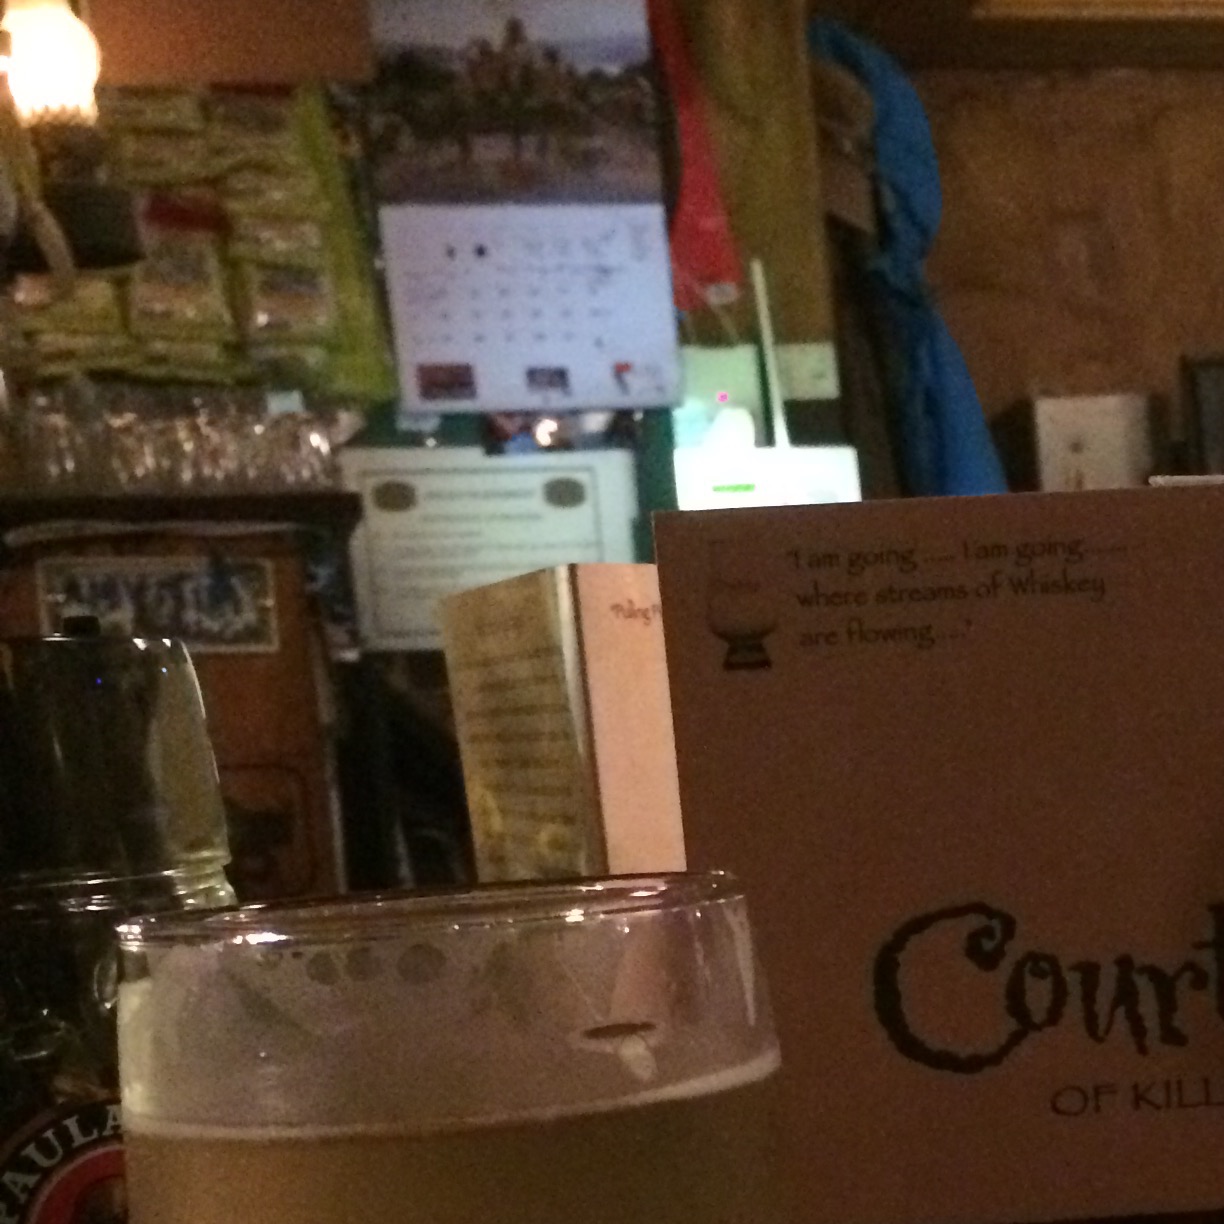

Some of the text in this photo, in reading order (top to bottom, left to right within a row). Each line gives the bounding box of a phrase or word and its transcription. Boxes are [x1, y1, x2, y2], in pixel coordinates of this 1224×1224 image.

[796, 567, 1106, 608] where streams of Whiskey
[799, 629, 838, 648] are
[1050, 1082, 1118, 1118] OF
